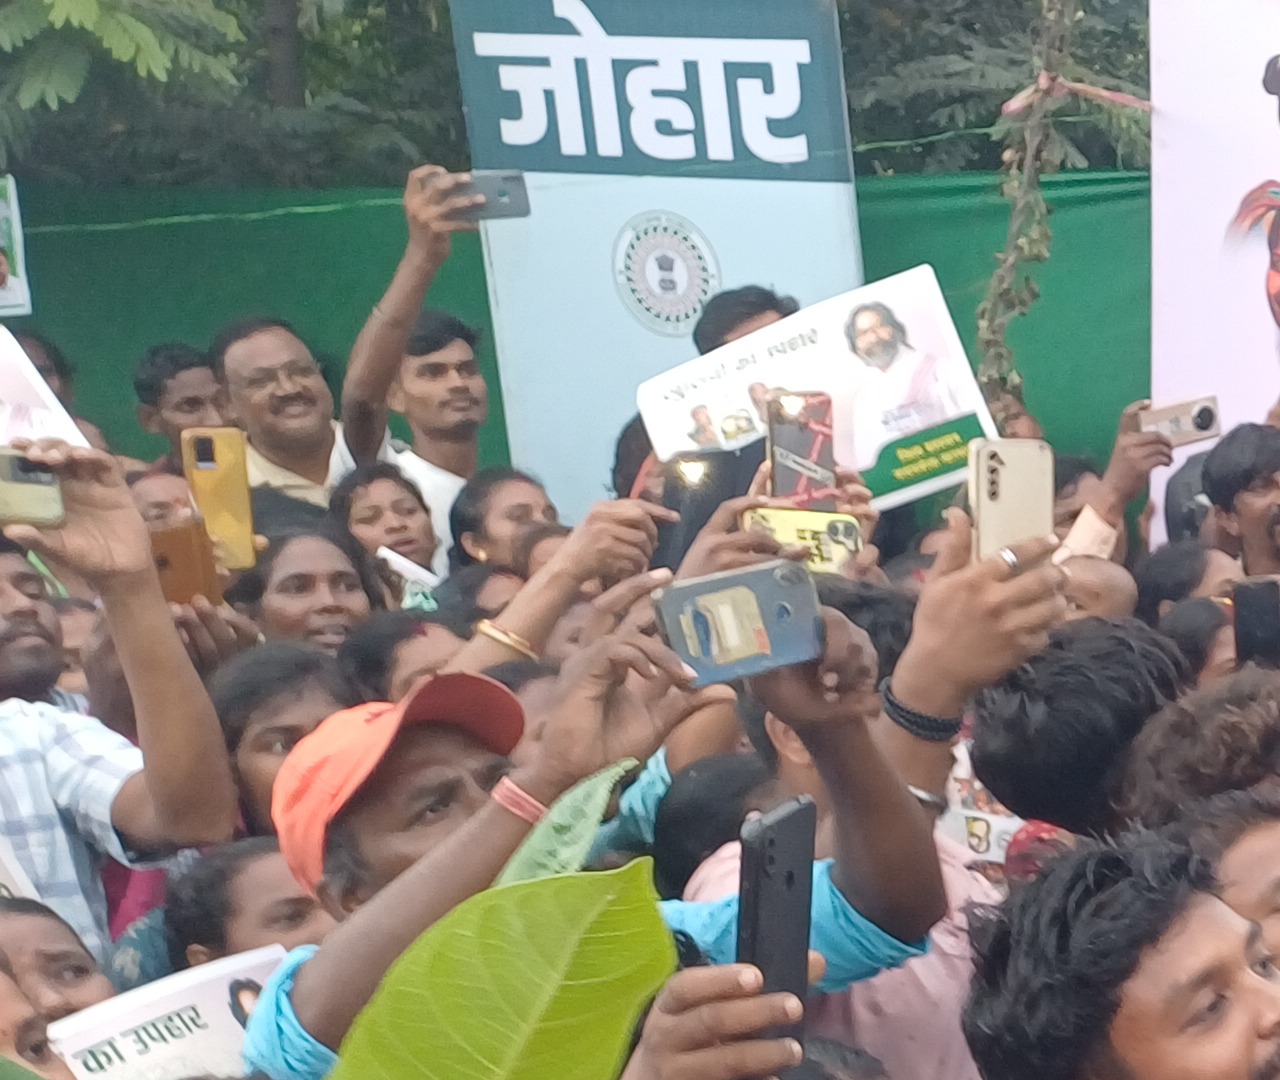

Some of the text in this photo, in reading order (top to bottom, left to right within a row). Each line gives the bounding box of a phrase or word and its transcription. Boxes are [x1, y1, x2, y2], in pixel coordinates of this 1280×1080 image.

[472, 0, 811, 164] जोहार
[71, 1003, 209, 1074] का उपहार
